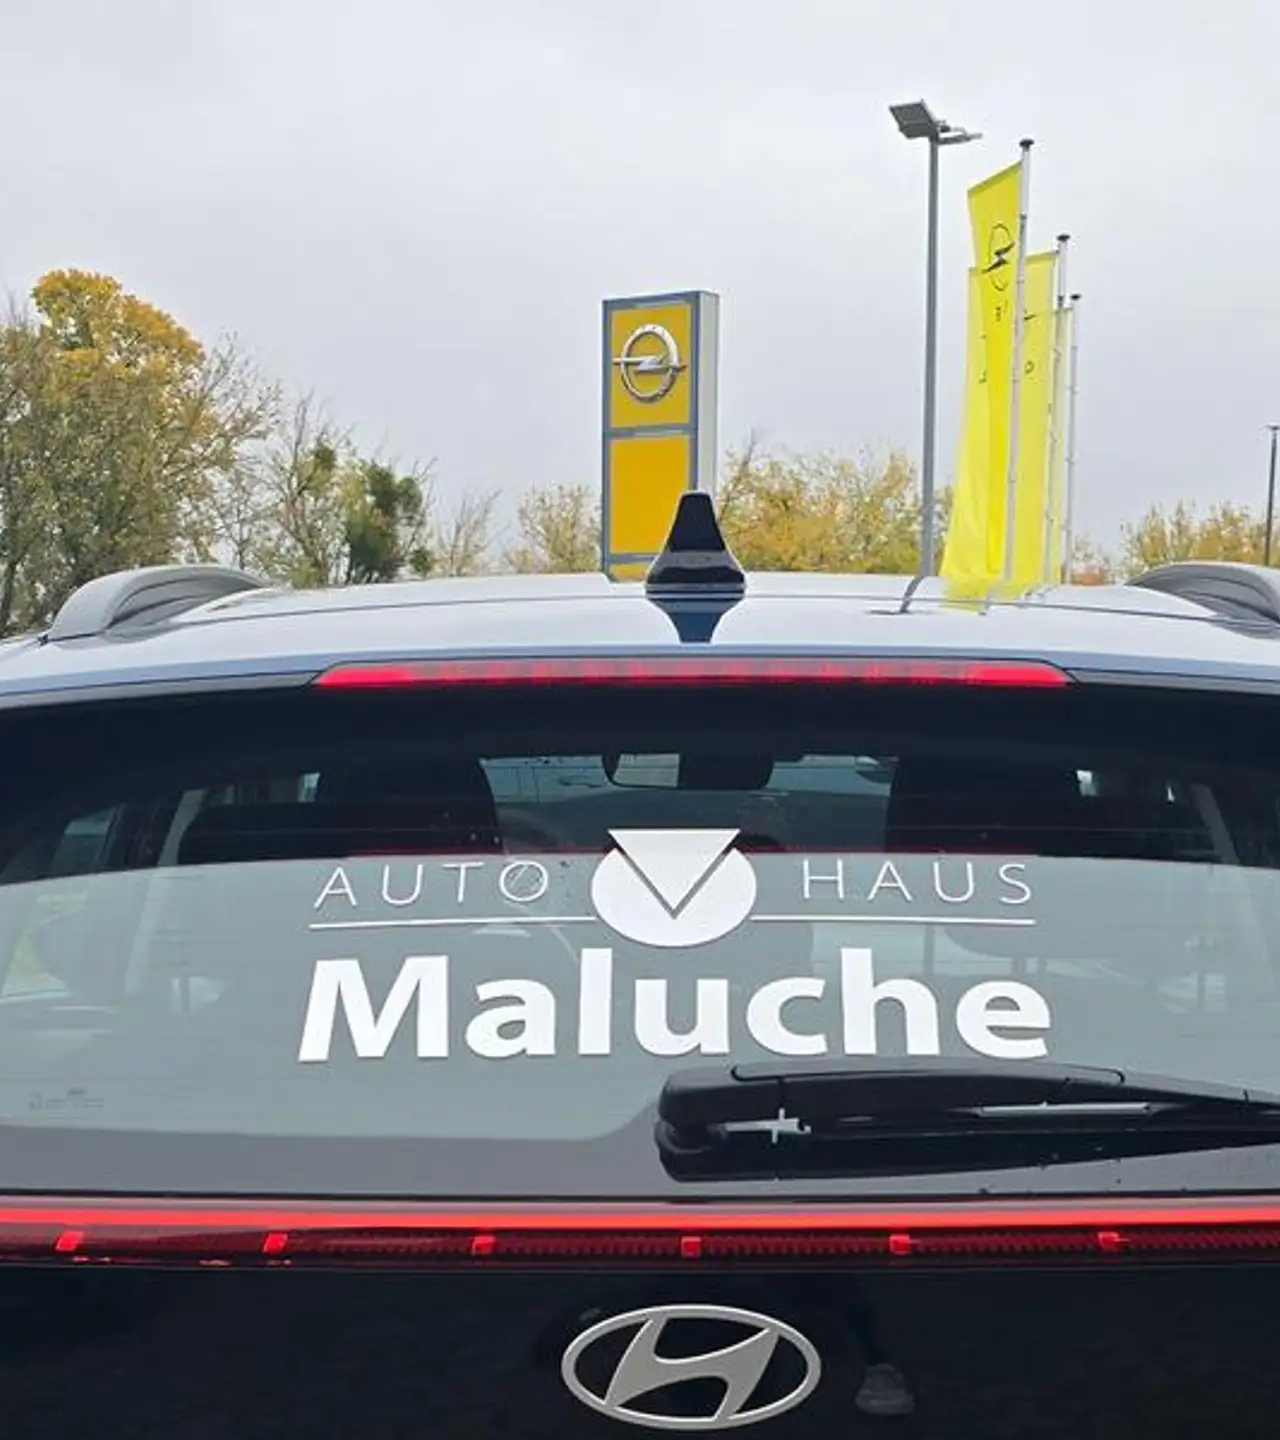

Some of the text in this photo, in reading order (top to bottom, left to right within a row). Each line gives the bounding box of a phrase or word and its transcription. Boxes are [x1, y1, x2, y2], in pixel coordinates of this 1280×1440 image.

[313, 858, 1033, 908] AUTO HAUS
[298, 947, 1052, 1063] Maluche
